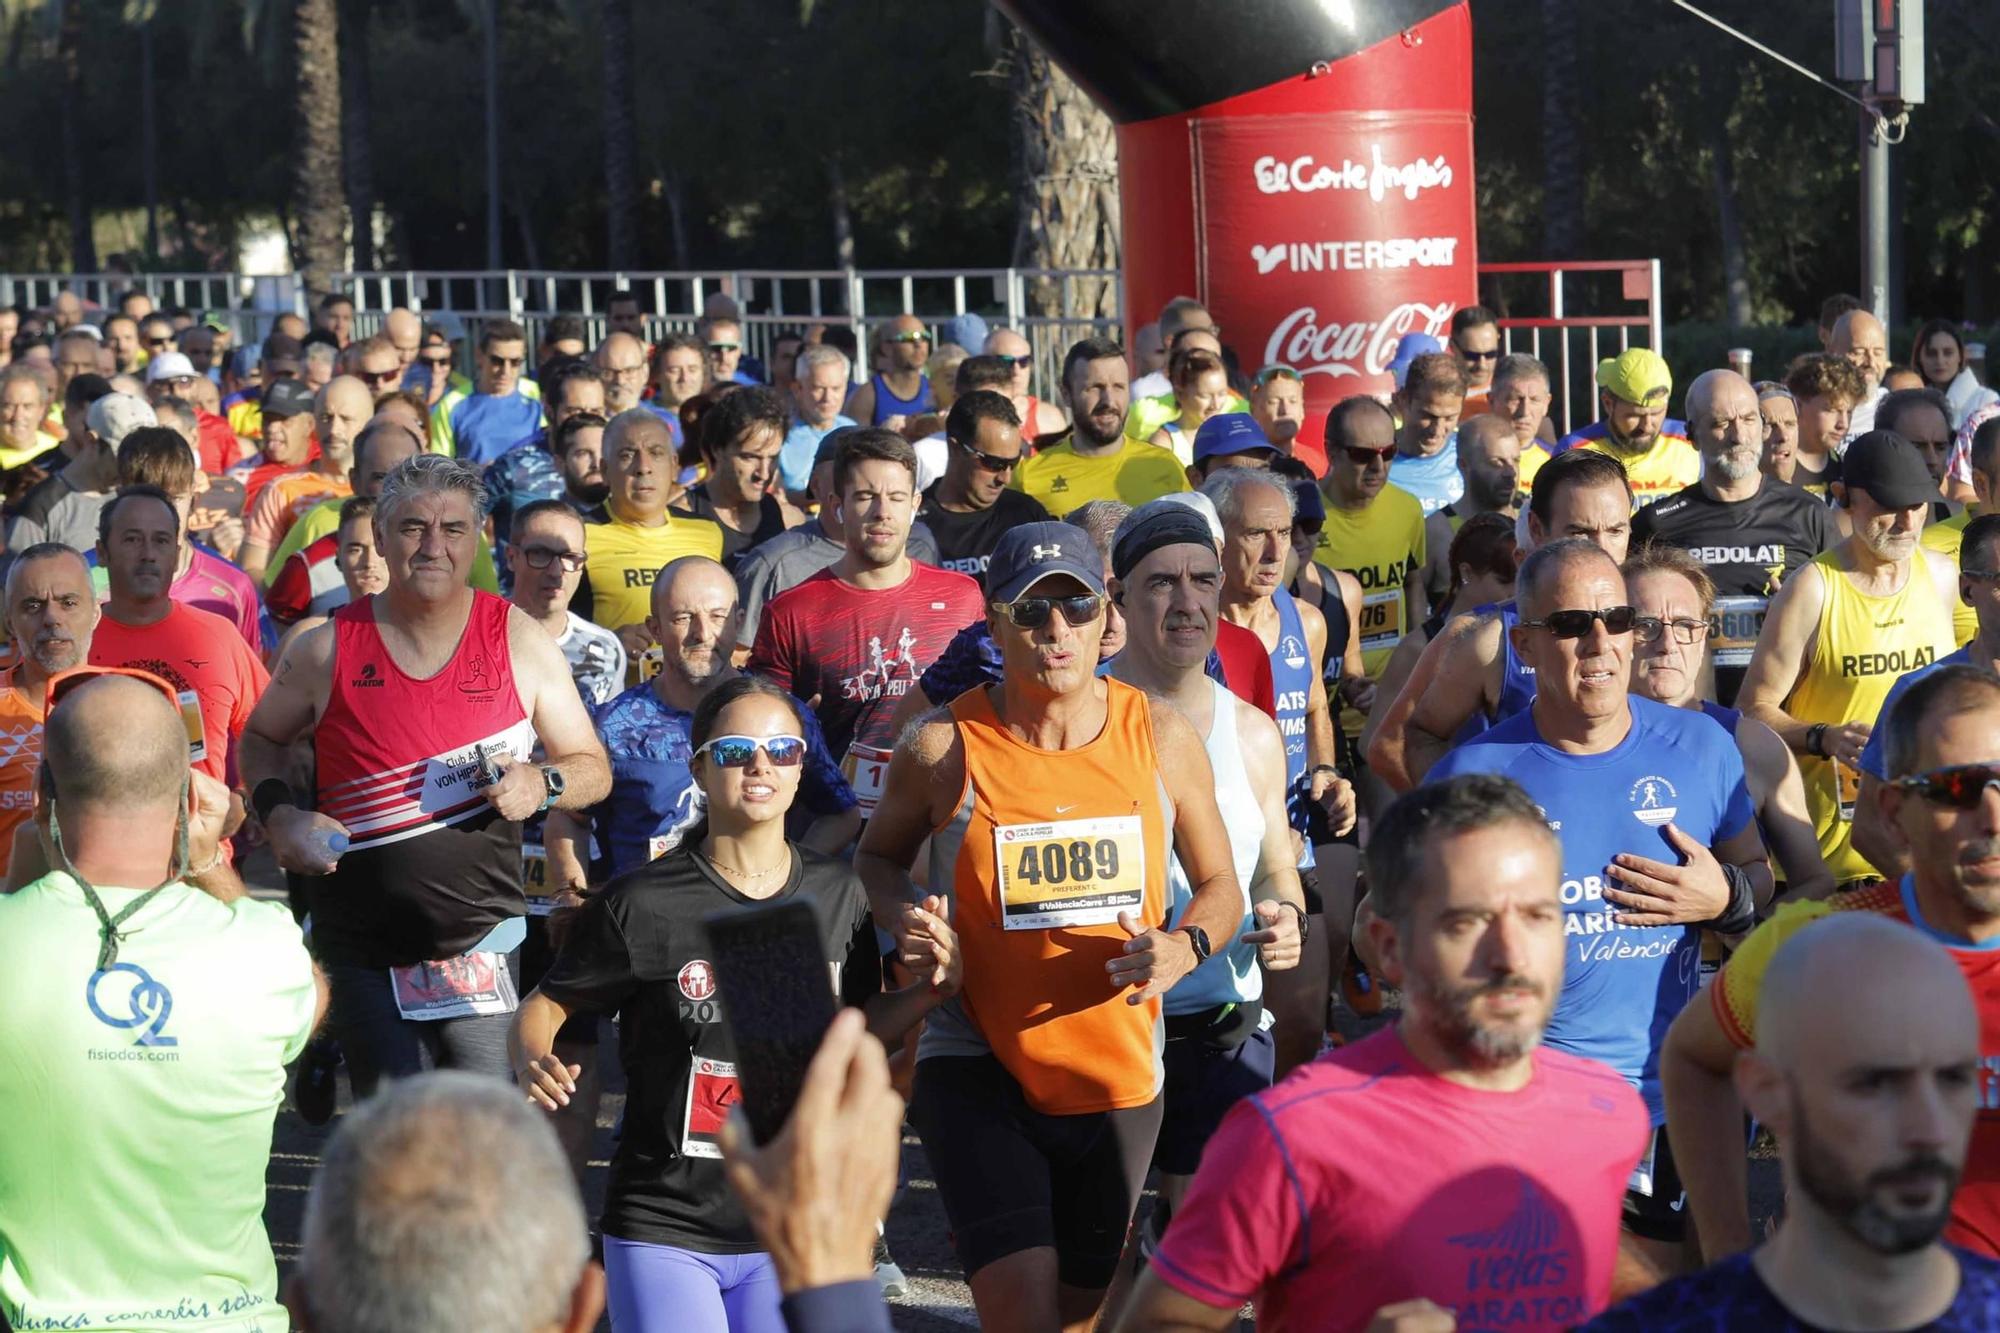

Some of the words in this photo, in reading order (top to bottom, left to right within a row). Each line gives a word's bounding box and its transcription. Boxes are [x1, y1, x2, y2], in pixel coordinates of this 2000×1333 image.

[1254, 156, 1290, 194] El
[1290, 155, 1367, 192] Corte
[1368, 144, 1453, 202] Inglés
[1290, 237, 1457, 272] INTERSPORT
[942, 554, 993, 576] REDO
[1360, 604, 1386, 628] 76
[1842, 646, 1936, 678] REDOLAT
[352, 679, 385, 688] VIATOR
[1276, 690, 1307, 712] ATS
[1278, 716, 1306, 736] IMS
[446, 755, 467, 769] Club
[468, 740, 507, 761] Attismo
[435, 772, 457, 789] VON
[1017, 838, 1120, 886] 4089
[1052, 885, 1092, 893] PREFERENT
[1038, 898, 1103, 911] #ValènciaCorre
[1579, 934, 1678, 963] València
[679, 1001, 722, 1024] 20
[88, 1049, 179, 1061] fisiodos.com
[1466, 1248, 1569, 1294] velas
[11, 1303, 92, 1330] Nunca
